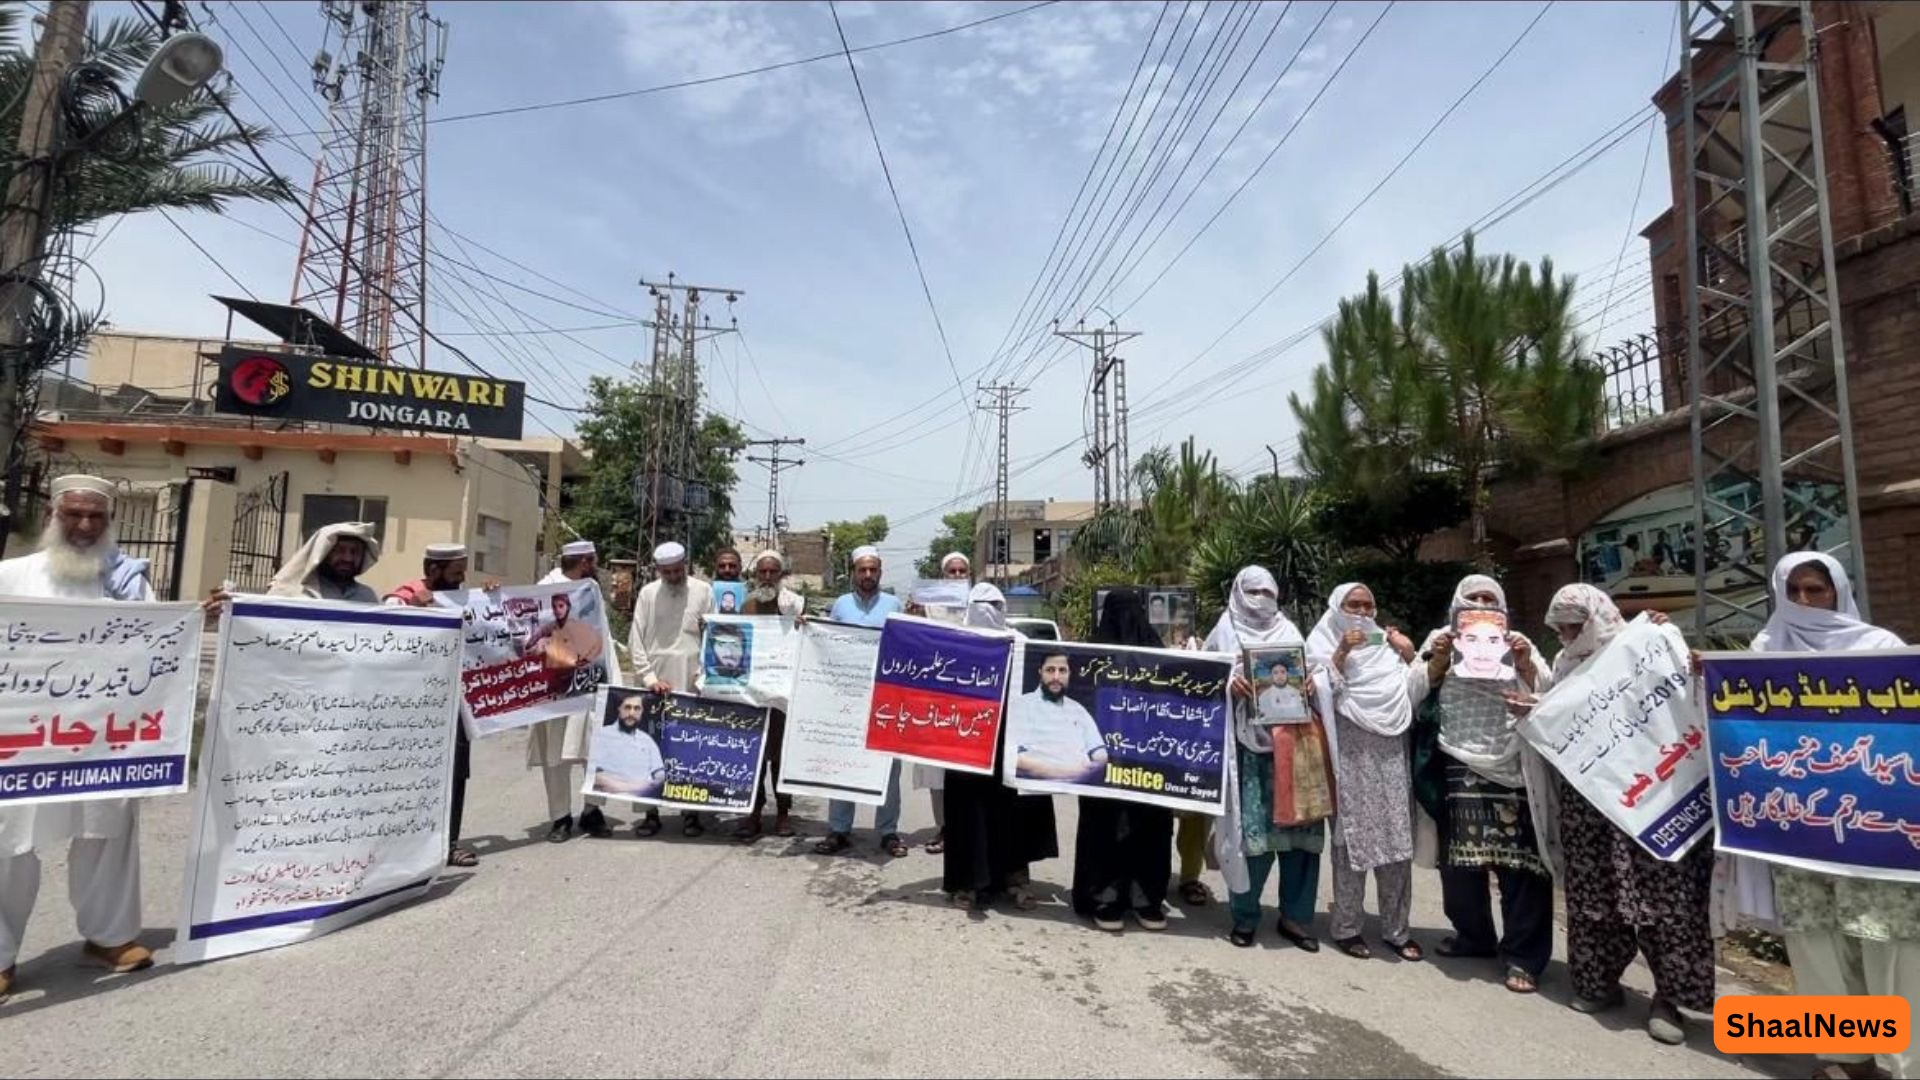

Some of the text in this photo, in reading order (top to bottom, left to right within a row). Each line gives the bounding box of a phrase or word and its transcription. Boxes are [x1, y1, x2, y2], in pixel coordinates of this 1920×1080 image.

[307, 362, 507, 407] SHINWARI
[347, 400, 471, 430] JONGARA
[0, 621, 35, 650] پنجا
[38, 632, 74, 644] سے
[150, 620, 185, 649] خیبر
[233, 631, 282, 651] صاحب
[32, 660, 64, 693] کو
[128, 655, 179, 696] منتقل
[935, 659, 957, 682] کے
[956, 667, 999, 687] انصاف
[1094, 656, 1113, 687] ختم
[1107, 666, 1151, 682] مقدمات
[1191, 681, 1212, 694] سید
[1206, 677, 1225, 697] عمر
[1645, 672, 1687, 708] 2019
[1712, 672, 1920, 716] ناب فیلڈ مارشل
[912, 704, 960, 727] انصاف
[958, 708, 995, 736] ہمیں
[1110, 697, 1221, 728] کیا شفاف نظام انصاف
[105, 709, 164, 750] لایا
[1137, 731, 1164, 753] نہیں
[1160, 737, 1178, 757] حق
[1177, 740, 1188, 756] کا
[1184, 741, 1212, 764] شہری
[1206, 751, 1221, 764] ہر
[1719, 738, 1788, 778] صاحب
[1778, 735, 1821, 779] منیر
[1808, 734, 1875, 775] آصف
[32, 770, 57, 790] OF
[61, 765, 121, 788] HUMAN
[125, 762, 173, 783] RIGHT
[1104, 762, 1164, 791] Justice
[1184, 772, 1200, 784] For
[1869, 752, 1908, 785] سید
[663, 780, 709, 803] Justice
[1164, 782, 1218, 799] Umar Sayed
[1727, 791, 1757, 828] ہیں
[1801, 787, 1836, 826] کے
[1651, 802, 1706, 848] DEFENCE
[1859, 810, 1899, 832] سے
